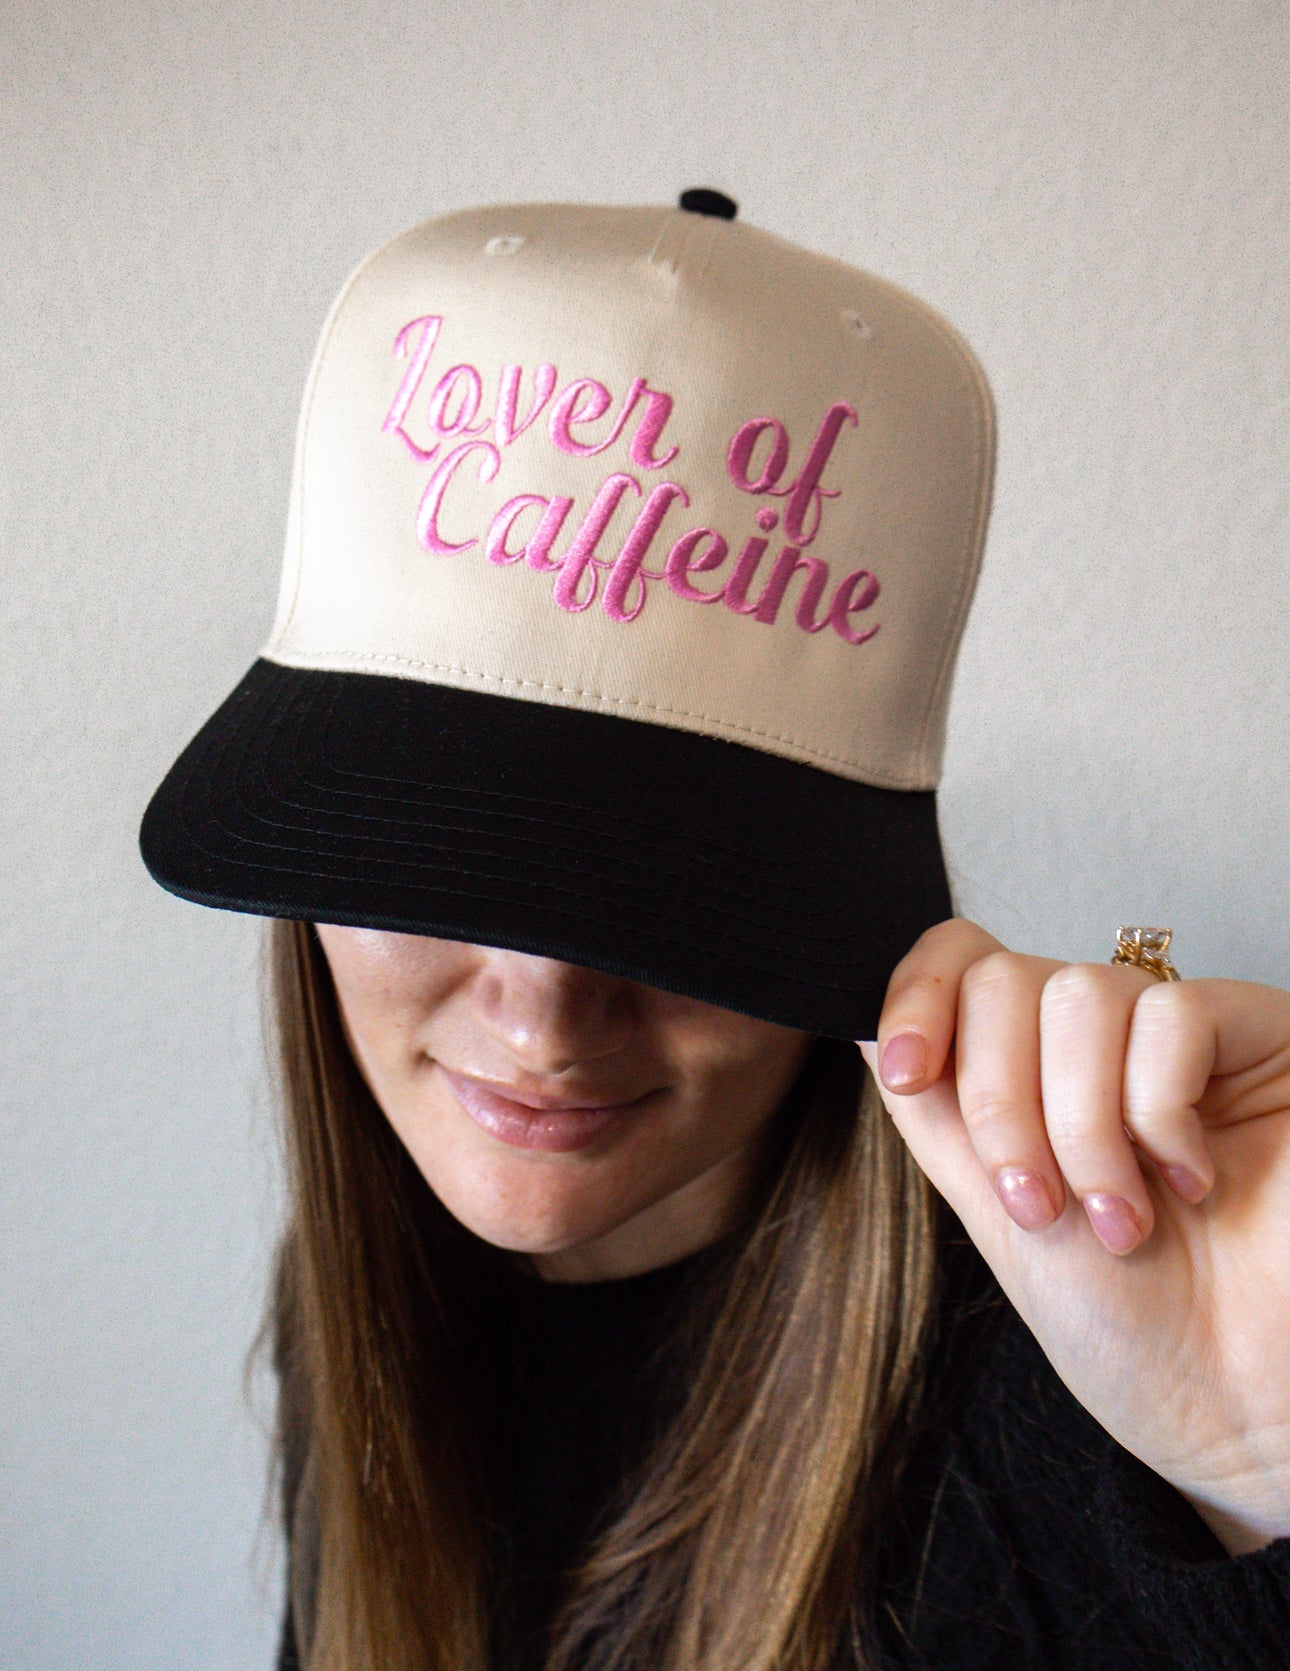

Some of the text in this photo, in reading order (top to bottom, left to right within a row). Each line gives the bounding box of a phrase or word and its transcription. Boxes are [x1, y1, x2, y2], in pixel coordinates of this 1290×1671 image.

[382, 315, 859, 547] Lover of
[416, 440, 881, 645] Caffeine
